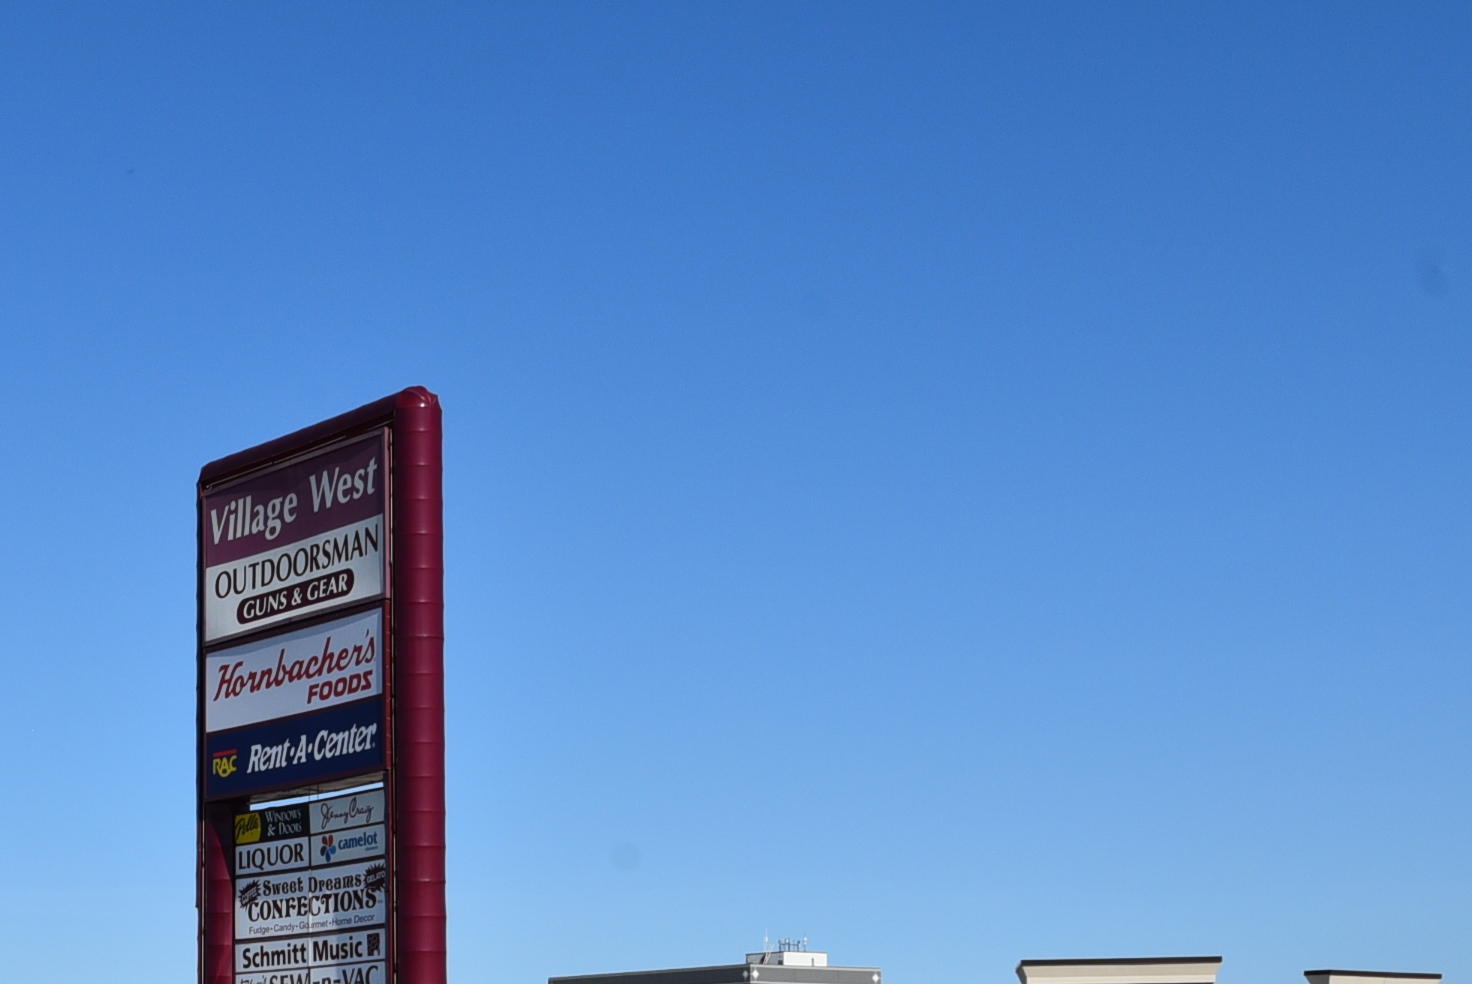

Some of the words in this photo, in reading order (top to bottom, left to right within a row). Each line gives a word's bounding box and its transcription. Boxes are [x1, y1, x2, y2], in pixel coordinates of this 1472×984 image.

[211, 493, 298, 544] Village
[309, 456, 377, 512] West
[215, 523, 379, 599] OUTDOORSMAN
[243, 590, 288, 619] GUNS
[291, 586, 303, 607] &
[307, 573, 348, 602] GEAR
[213, 629, 376, 702] Hornbacher's
[307, 669, 374, 704] FOODS
[267, 823, 277, 837] &
[338, 832, 378, 850] camelot
[238, 843, 304, 870] LIQUOR
[262, 877, 304, 896] Sweet
[308, 873, 362, 893] Dreams
[248, 888, 377, 922] CONFECTIONS
[242, 942, 306, 968] Schmitt
[313, 936, 363, 962] Music
